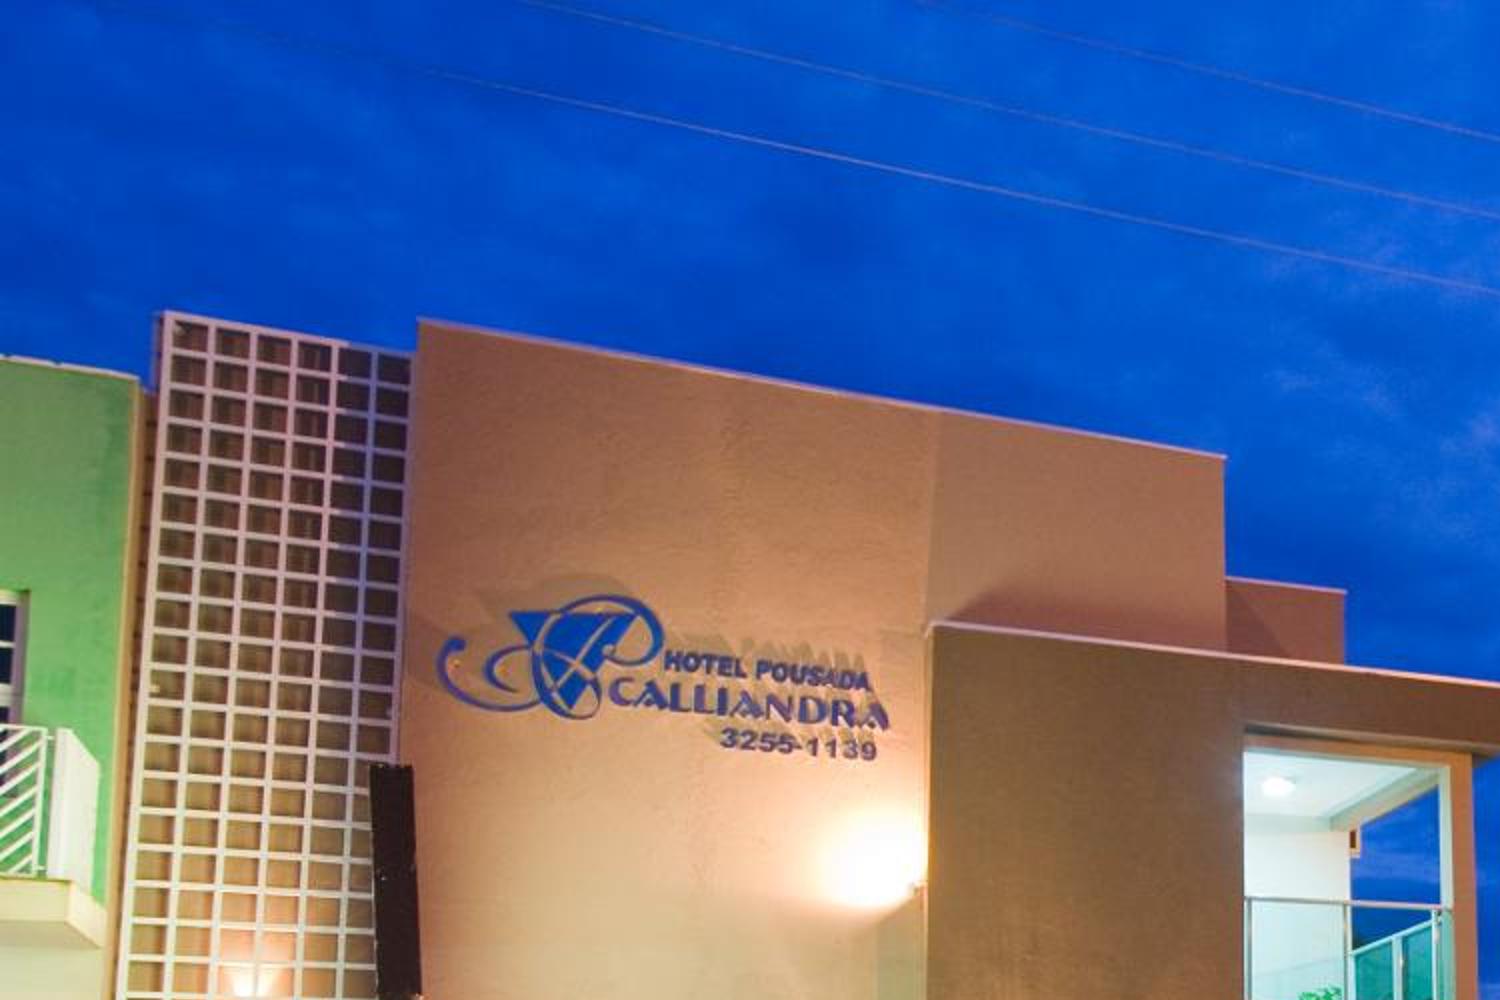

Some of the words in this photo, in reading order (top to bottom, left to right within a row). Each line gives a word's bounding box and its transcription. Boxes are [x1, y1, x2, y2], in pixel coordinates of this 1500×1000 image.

[664, 650, 747, 679] HOTEL
[756, 658, 873, 693] POUSADA
[609, 676, 890, 732] CALLIANDRA
[720, 727, 878, 761] 3255-1139
